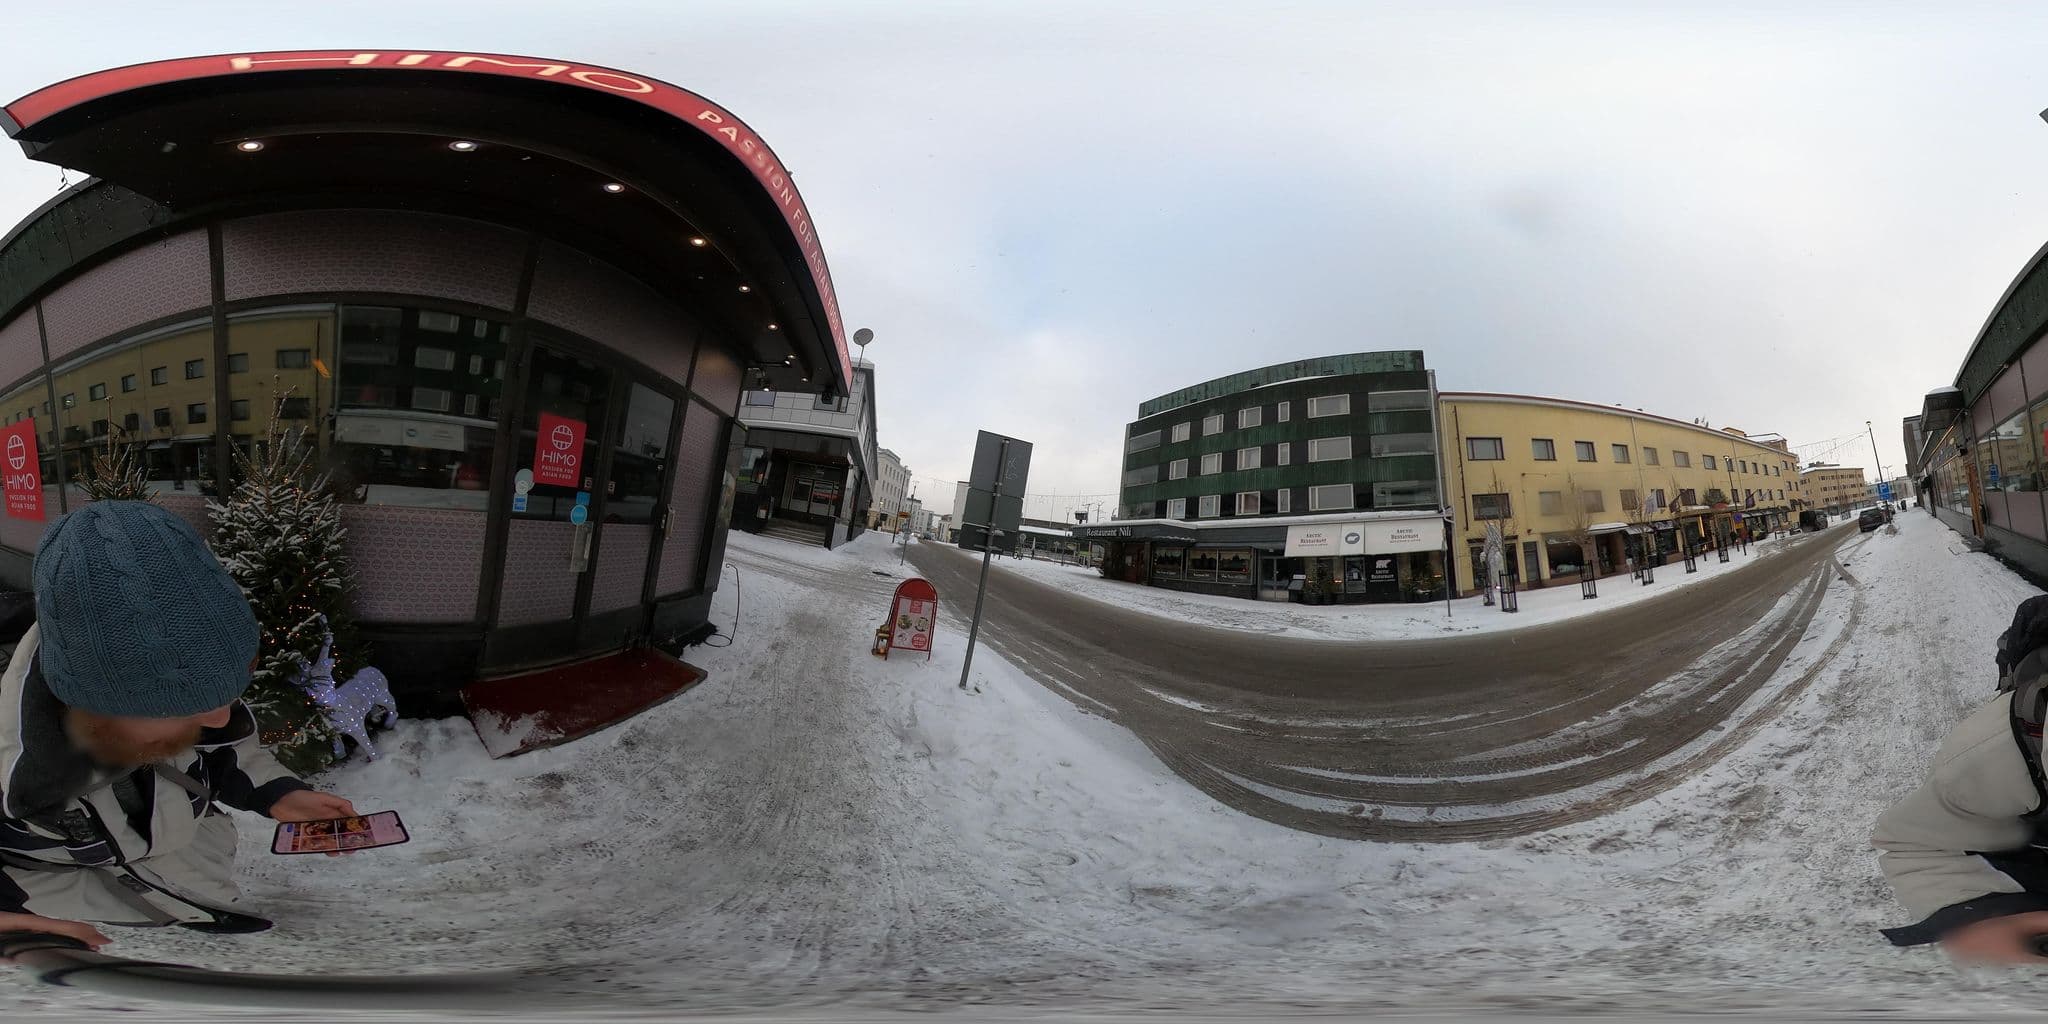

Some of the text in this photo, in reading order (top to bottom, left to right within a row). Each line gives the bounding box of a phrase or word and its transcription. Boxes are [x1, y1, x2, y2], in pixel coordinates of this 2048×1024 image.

[230, 54, 654, 93] HIMO
[697, 110, 793, 206] PASSION
[793, 208, 812, 249] FOR
[811, 250, 830, 298] ASIAN
[541, 450, 577, 466] HIMO
[6, 473, 36, 490] HIMO
[1086, 526, 1132, 537] Restaurant Nili
